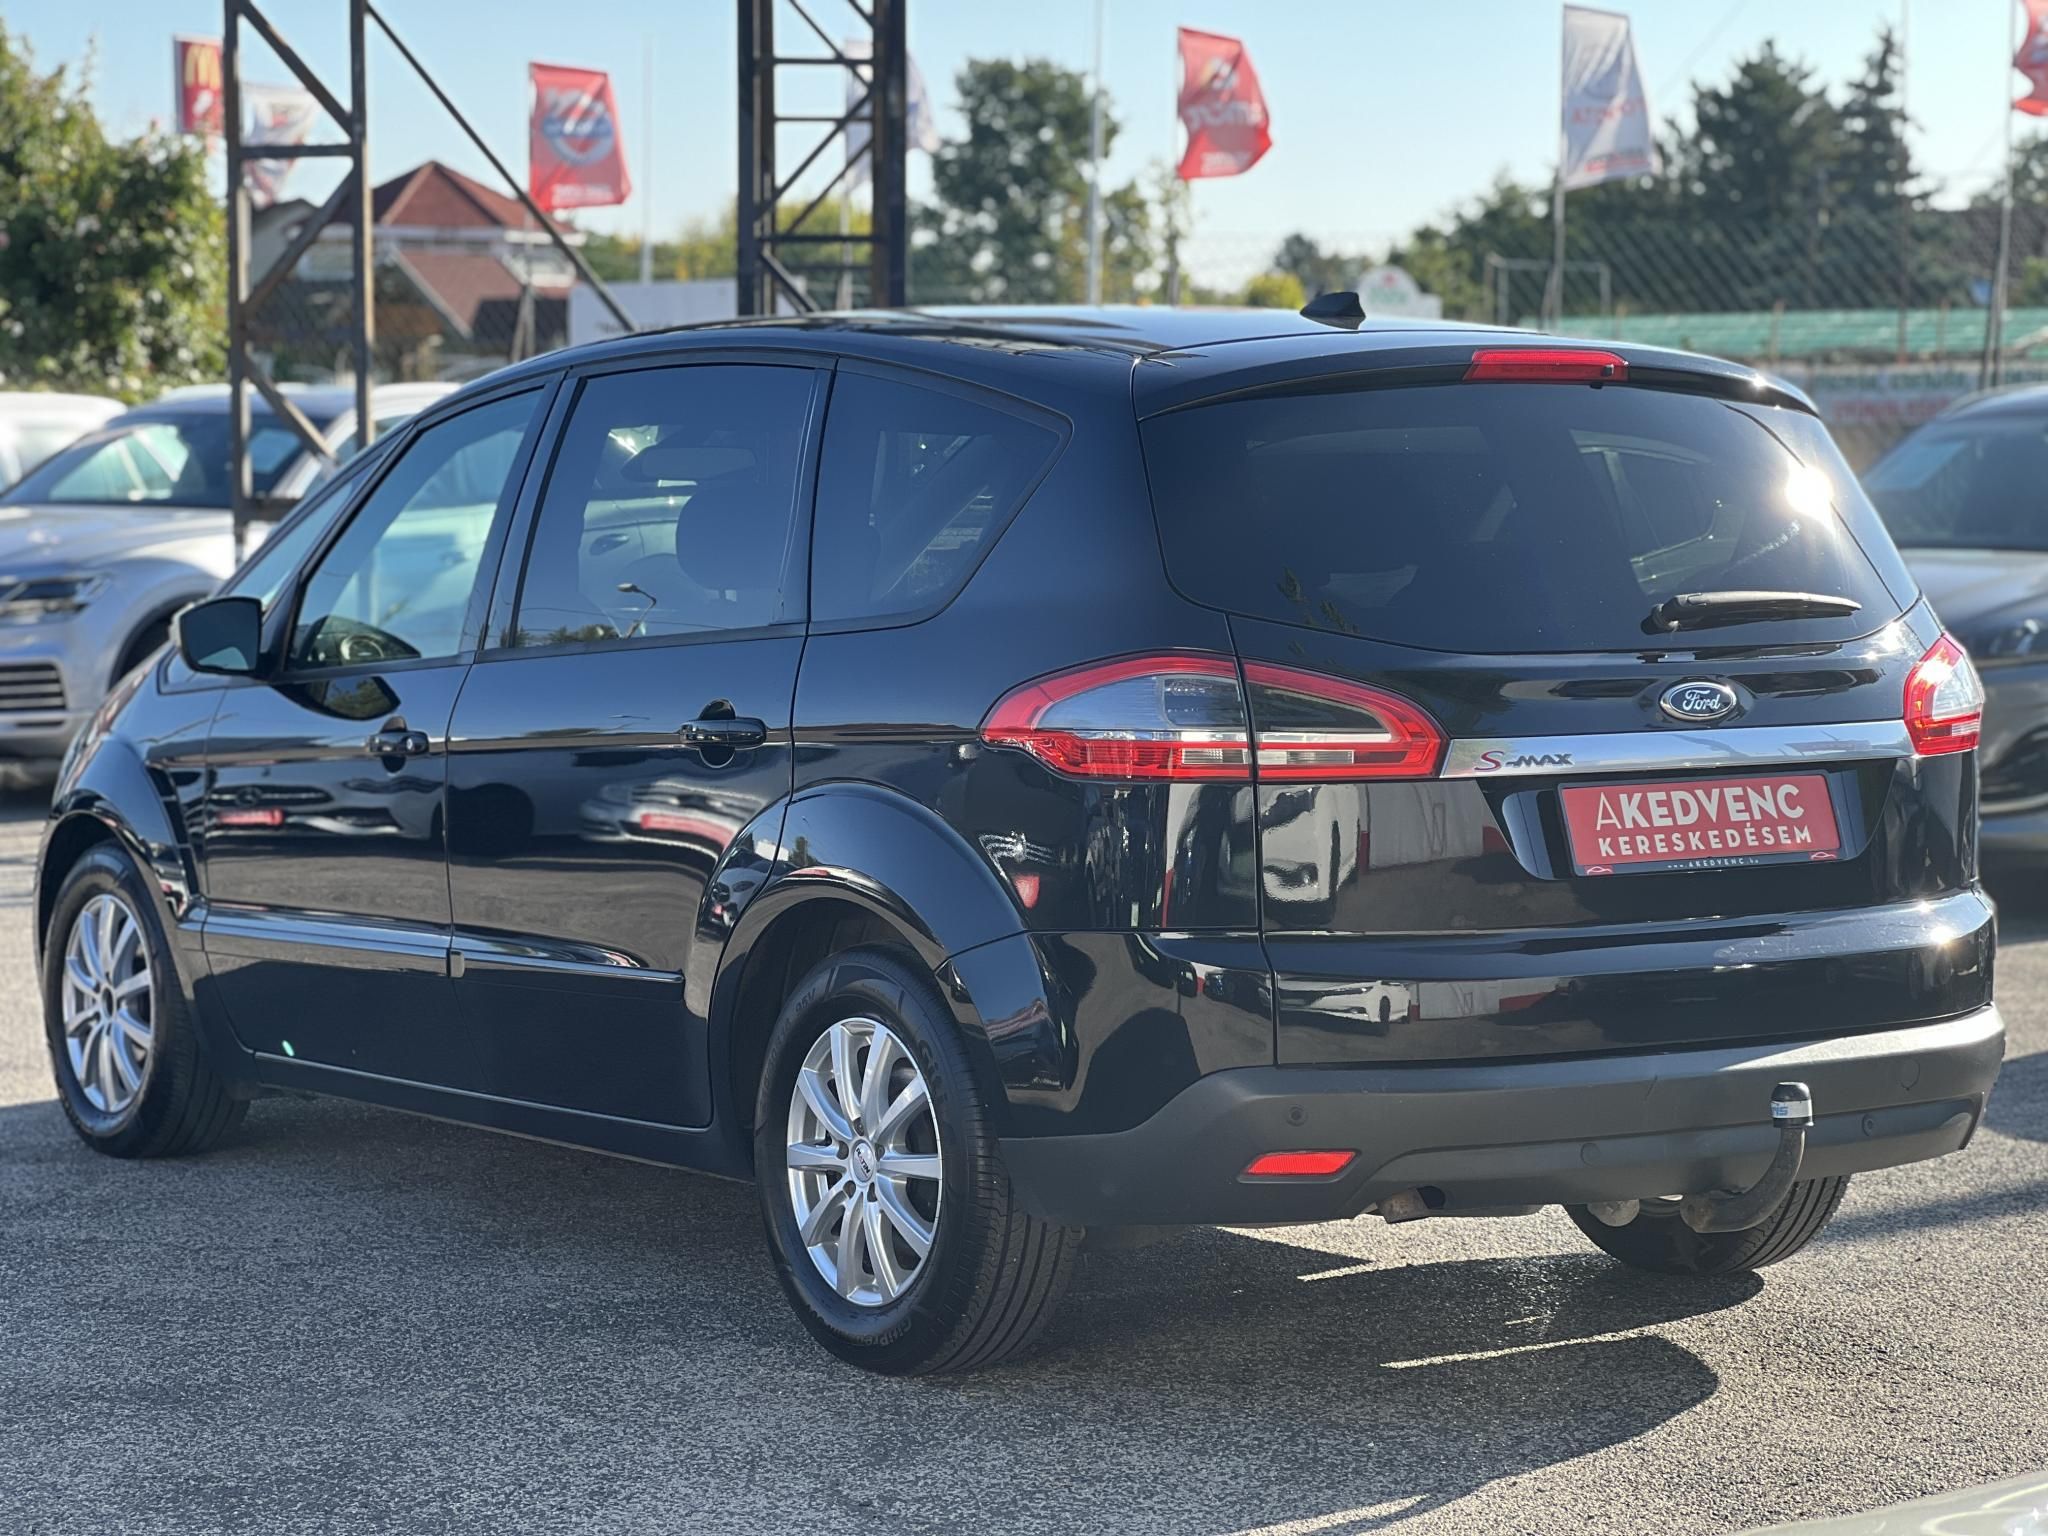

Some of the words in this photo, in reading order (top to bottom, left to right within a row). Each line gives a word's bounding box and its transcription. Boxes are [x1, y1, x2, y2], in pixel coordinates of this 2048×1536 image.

[1682, 689, 1720, 710] Ford
[1596, 784, 1804, 830] AKEDVENC
[1598, 822, 1812, 857] KERESKEDÉSEM
